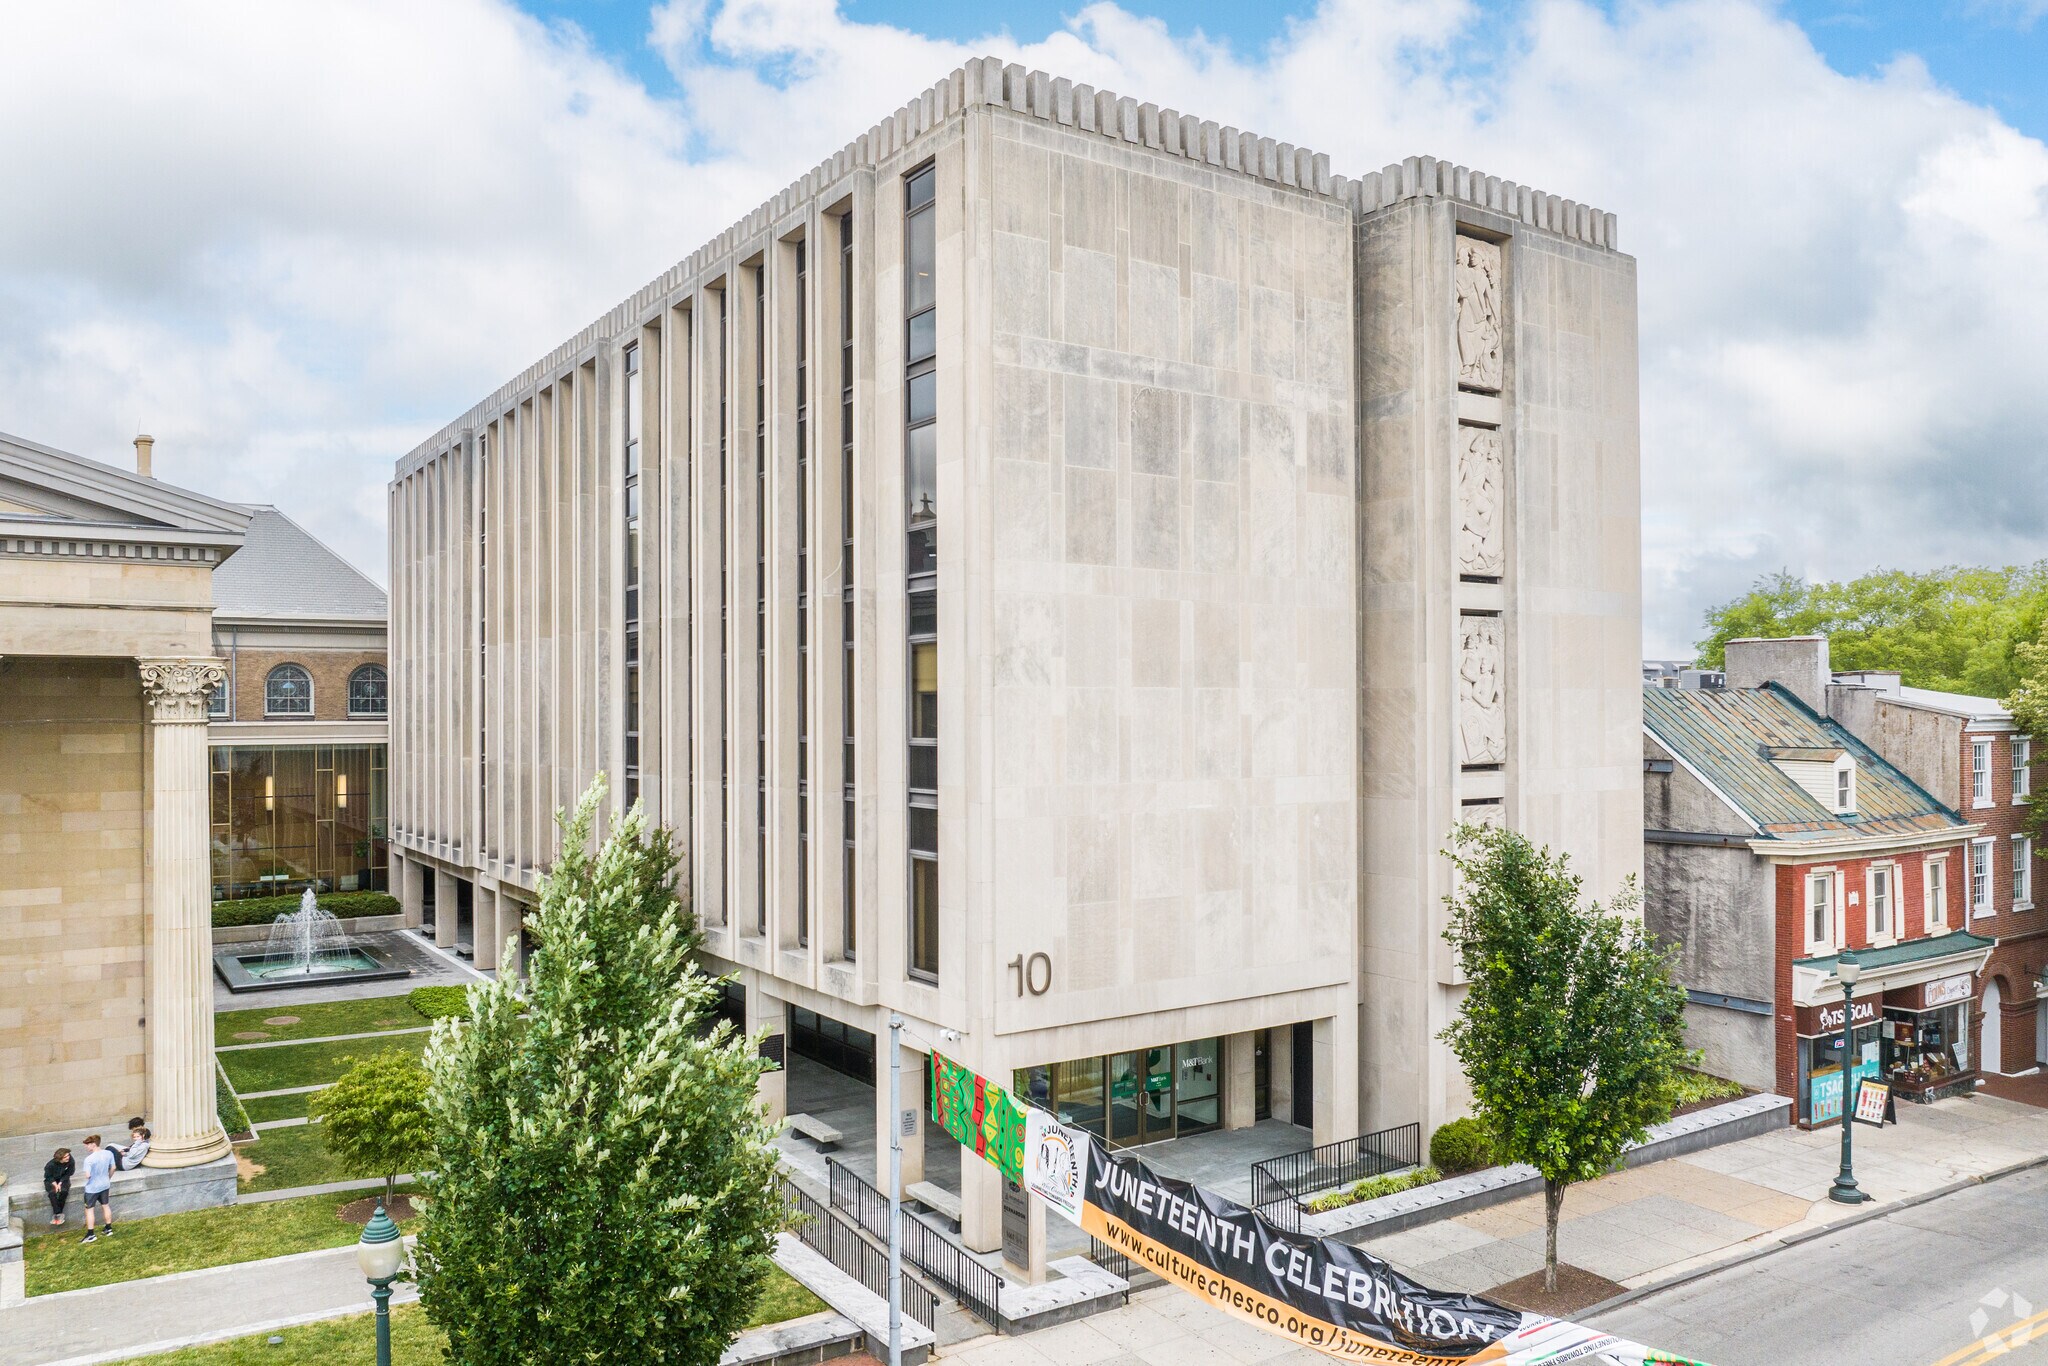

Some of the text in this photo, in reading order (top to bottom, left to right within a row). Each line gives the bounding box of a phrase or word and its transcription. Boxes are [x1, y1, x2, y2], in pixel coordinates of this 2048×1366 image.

[1008, 952, 1052, 998] 10
[1047, 1125, 1078, 1189] JUNETEENTH
[1003, 1204, 1026, 1220] BERNARDON
[1095, 1161, 1495, 1343] JUNETEENTH CELEBRATION
